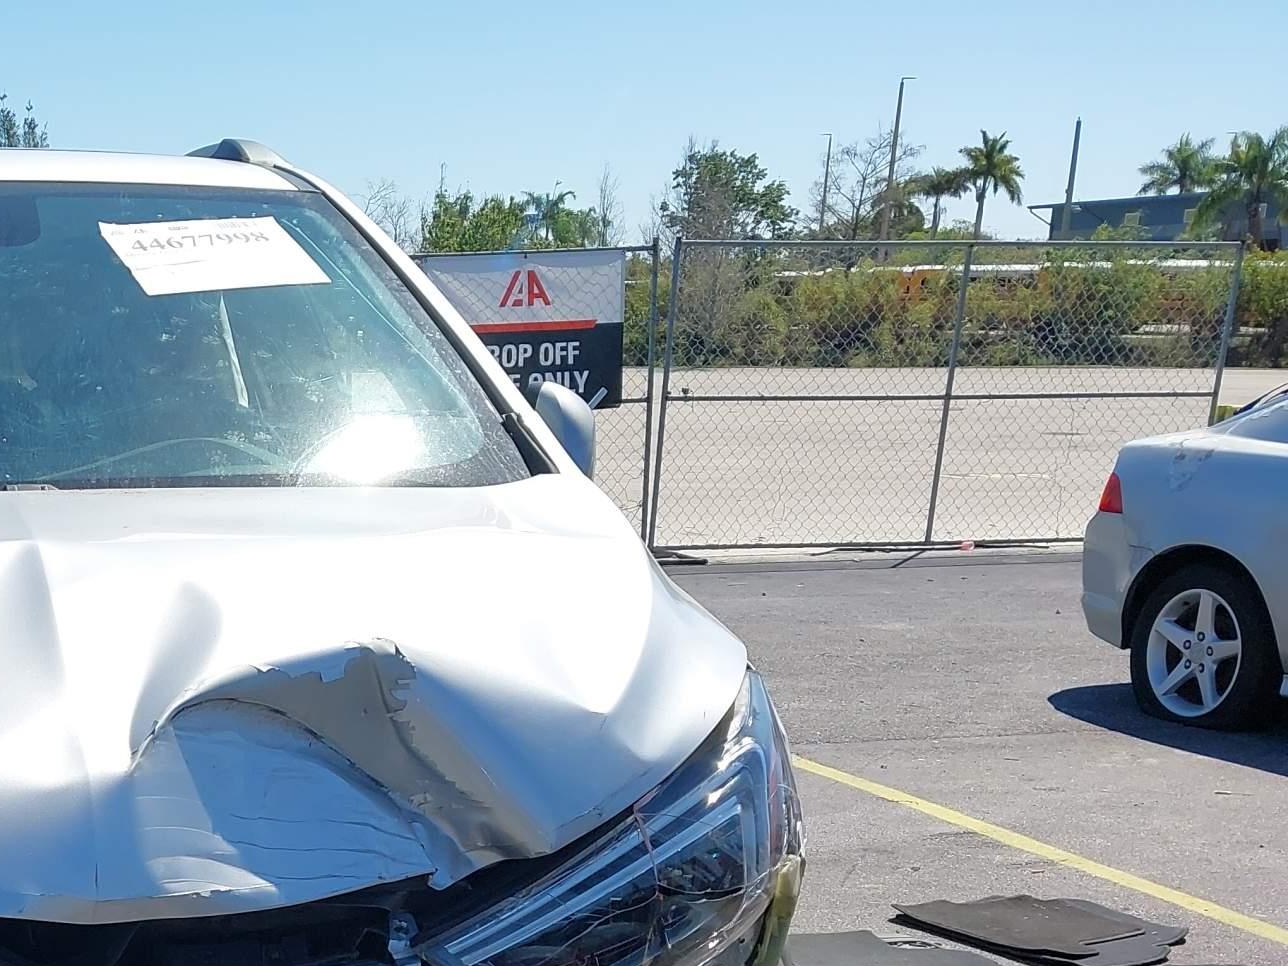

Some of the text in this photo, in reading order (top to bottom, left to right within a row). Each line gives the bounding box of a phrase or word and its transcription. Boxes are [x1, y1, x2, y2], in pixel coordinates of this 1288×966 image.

[132, 231, 270, 251] 44677998
[487, 341, 580, 368] ROP OFF
